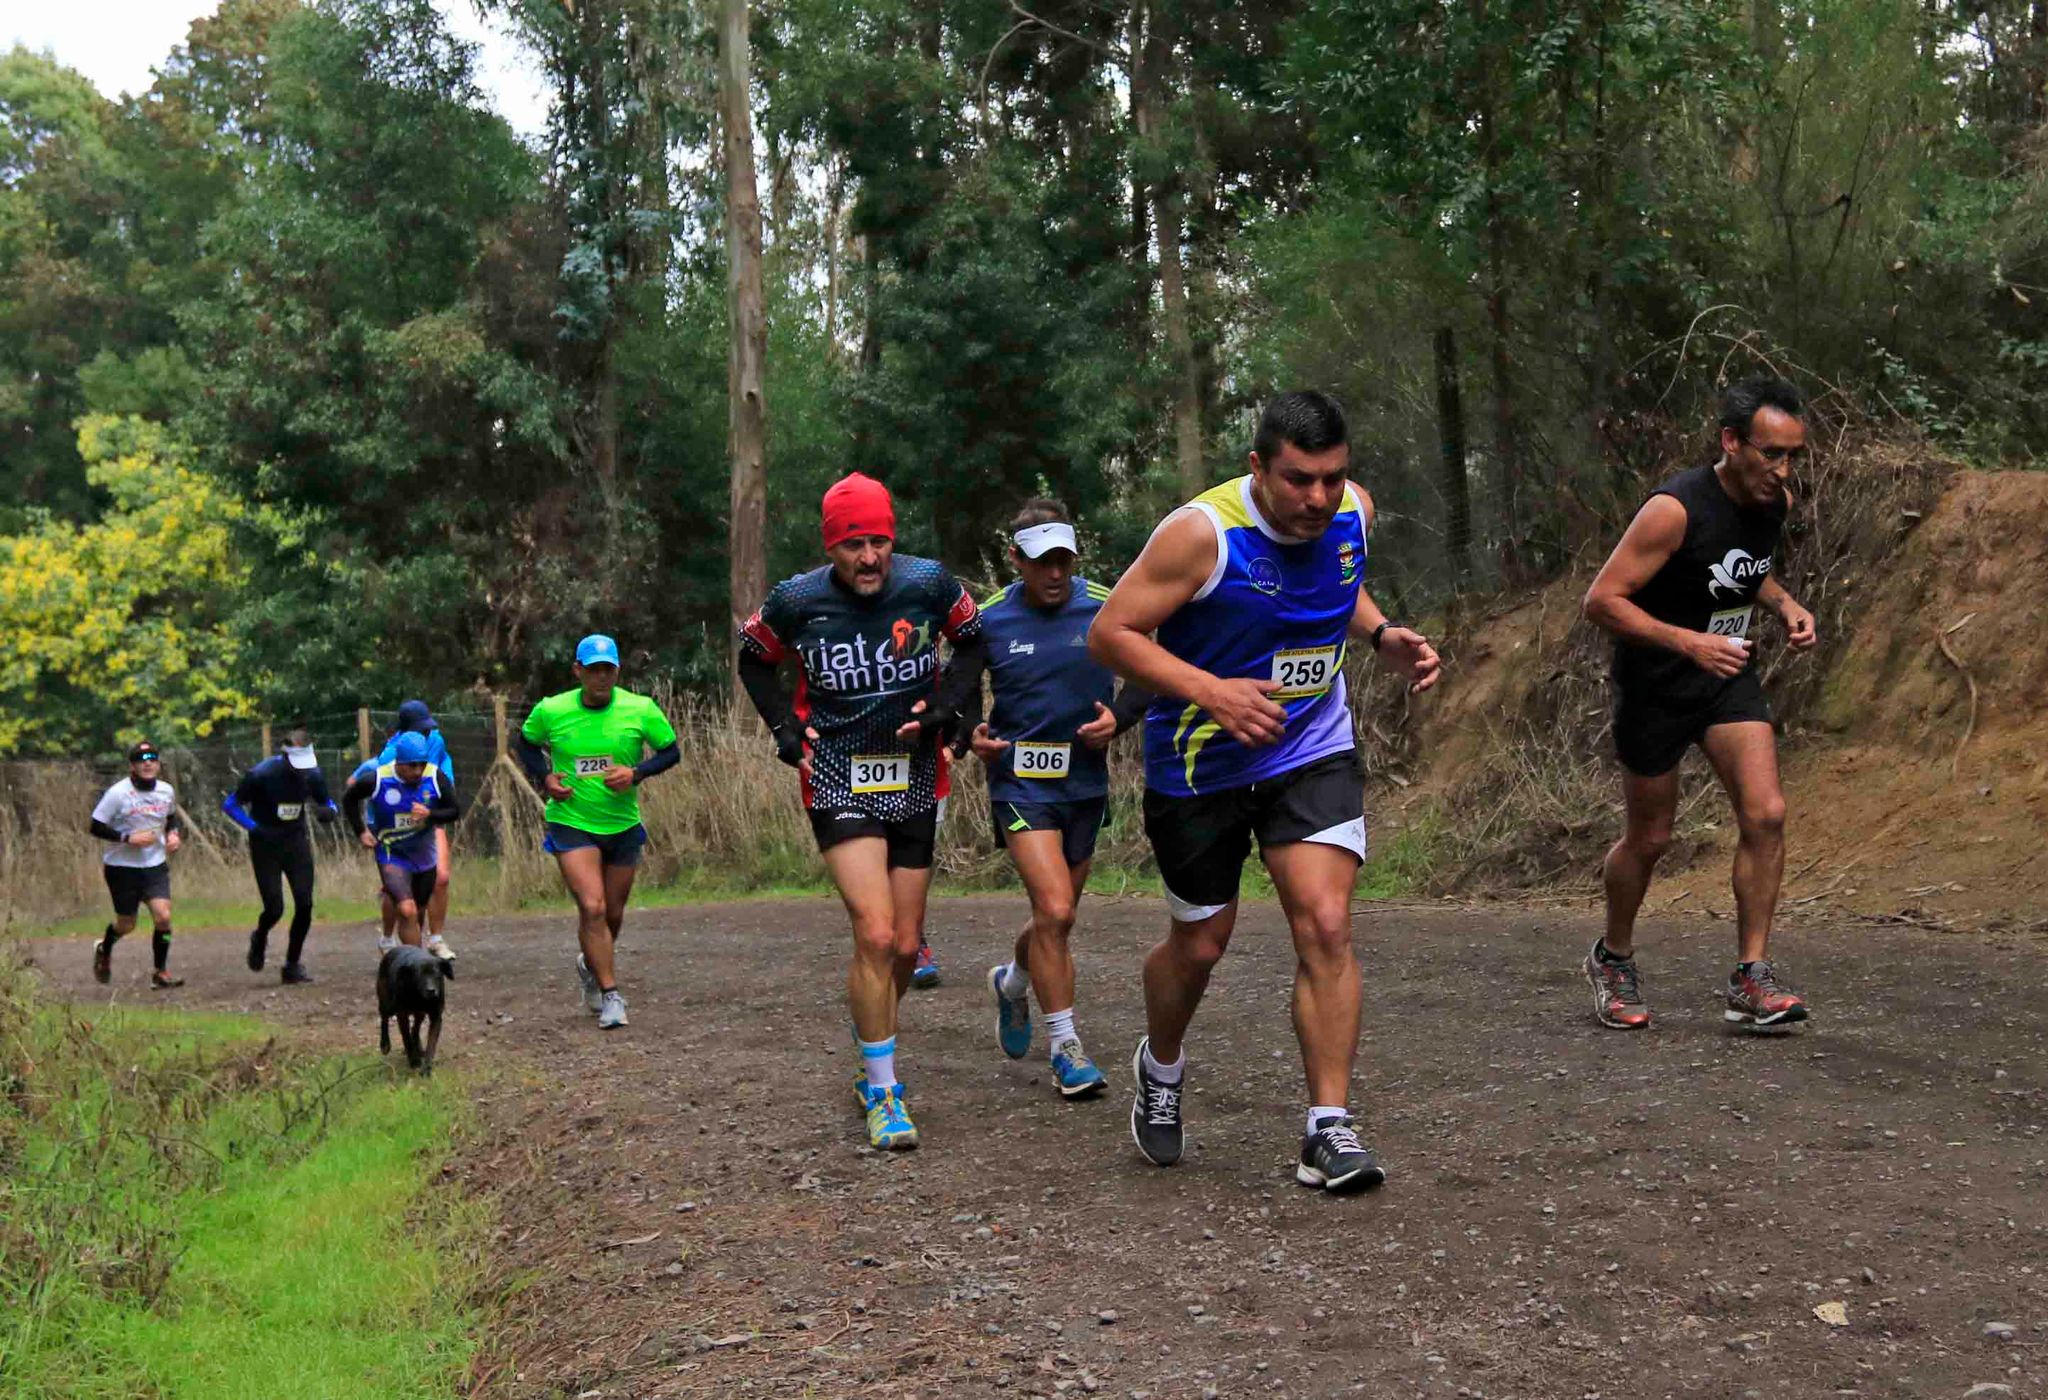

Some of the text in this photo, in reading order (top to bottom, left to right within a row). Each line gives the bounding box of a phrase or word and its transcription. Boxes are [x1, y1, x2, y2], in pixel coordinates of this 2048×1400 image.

[1713, 615, 1744, 635] 220
[1280, 659, 1326, 687] 259
[580, 759, 608, 773] 228
[1022, 751, 1063, 770] 306
[857, 762, 898, 783] 301
